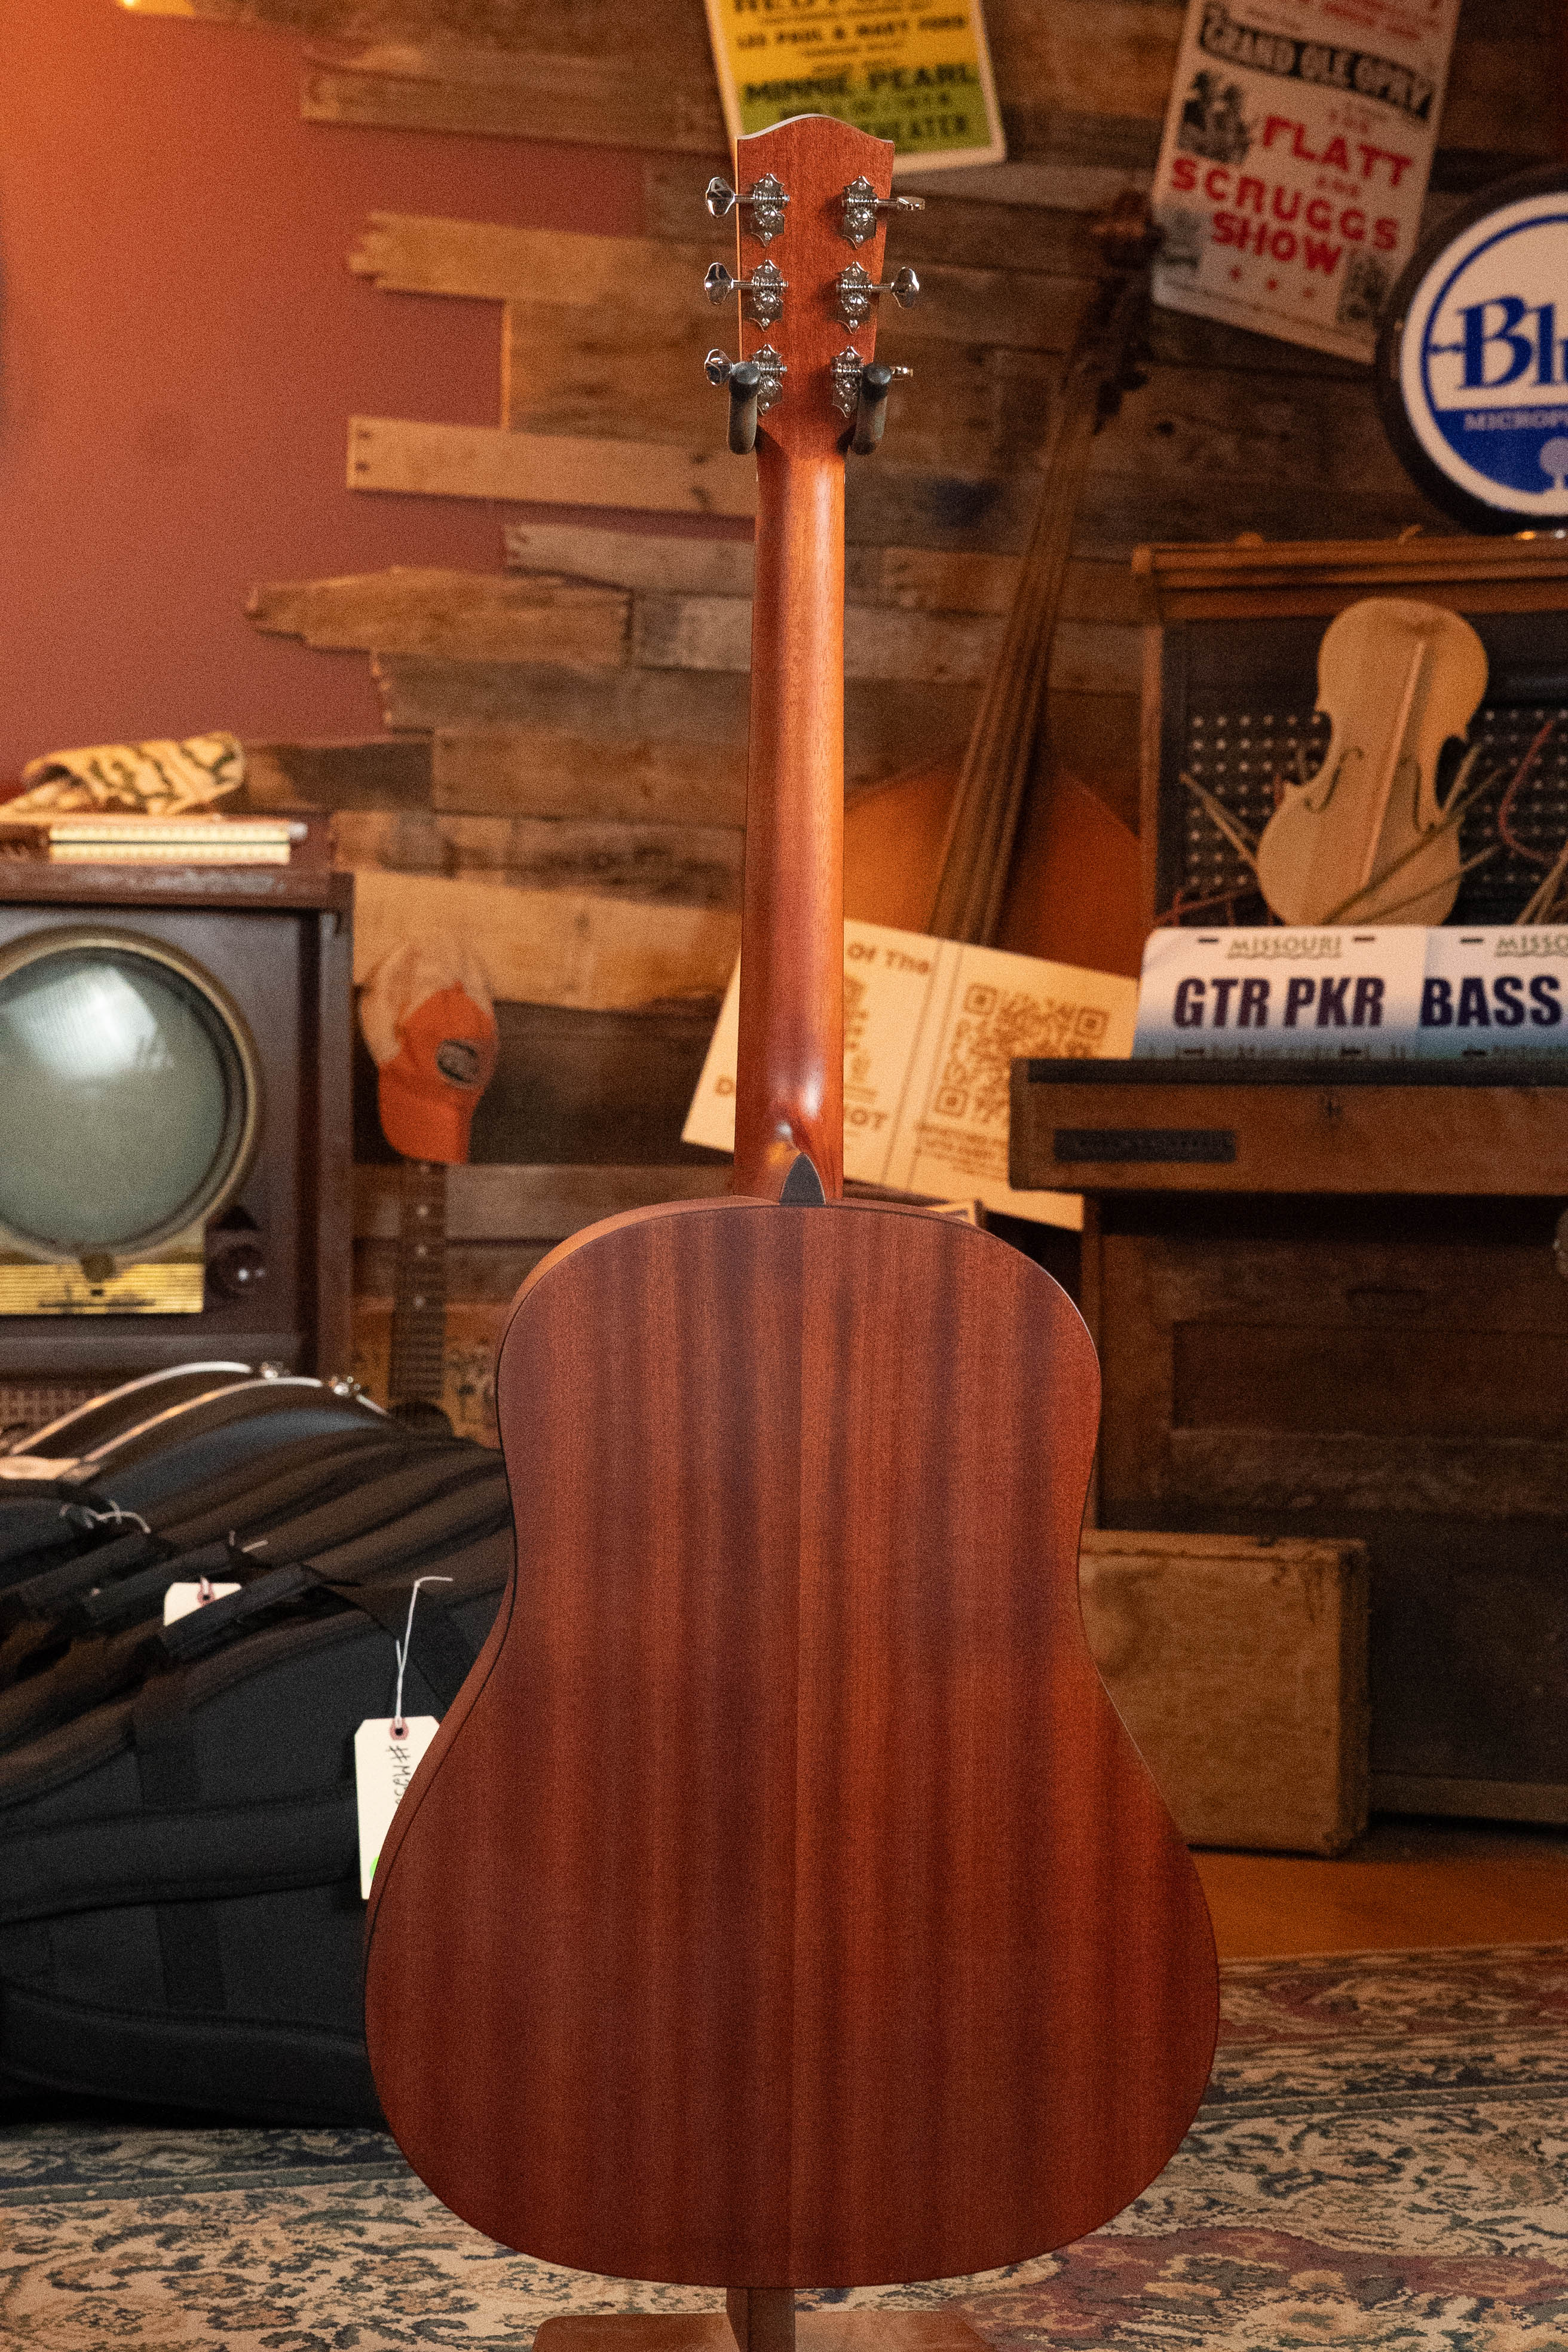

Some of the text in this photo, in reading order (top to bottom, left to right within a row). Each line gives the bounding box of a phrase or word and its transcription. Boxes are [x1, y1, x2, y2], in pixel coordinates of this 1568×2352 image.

[1263, 115, 1413, 187] FLATT
[1171, 158, 1400, 251] SCRUGGS
[1211, 211, 1343, 275] SHOW
[1464, 409, 1568, 431] MICROP
[1230, 933, 1342, 955] MISSOURI
[1173, 977, 1386, 1028] GTR PKR
[1419, 975, 1562, 1028] BASS
